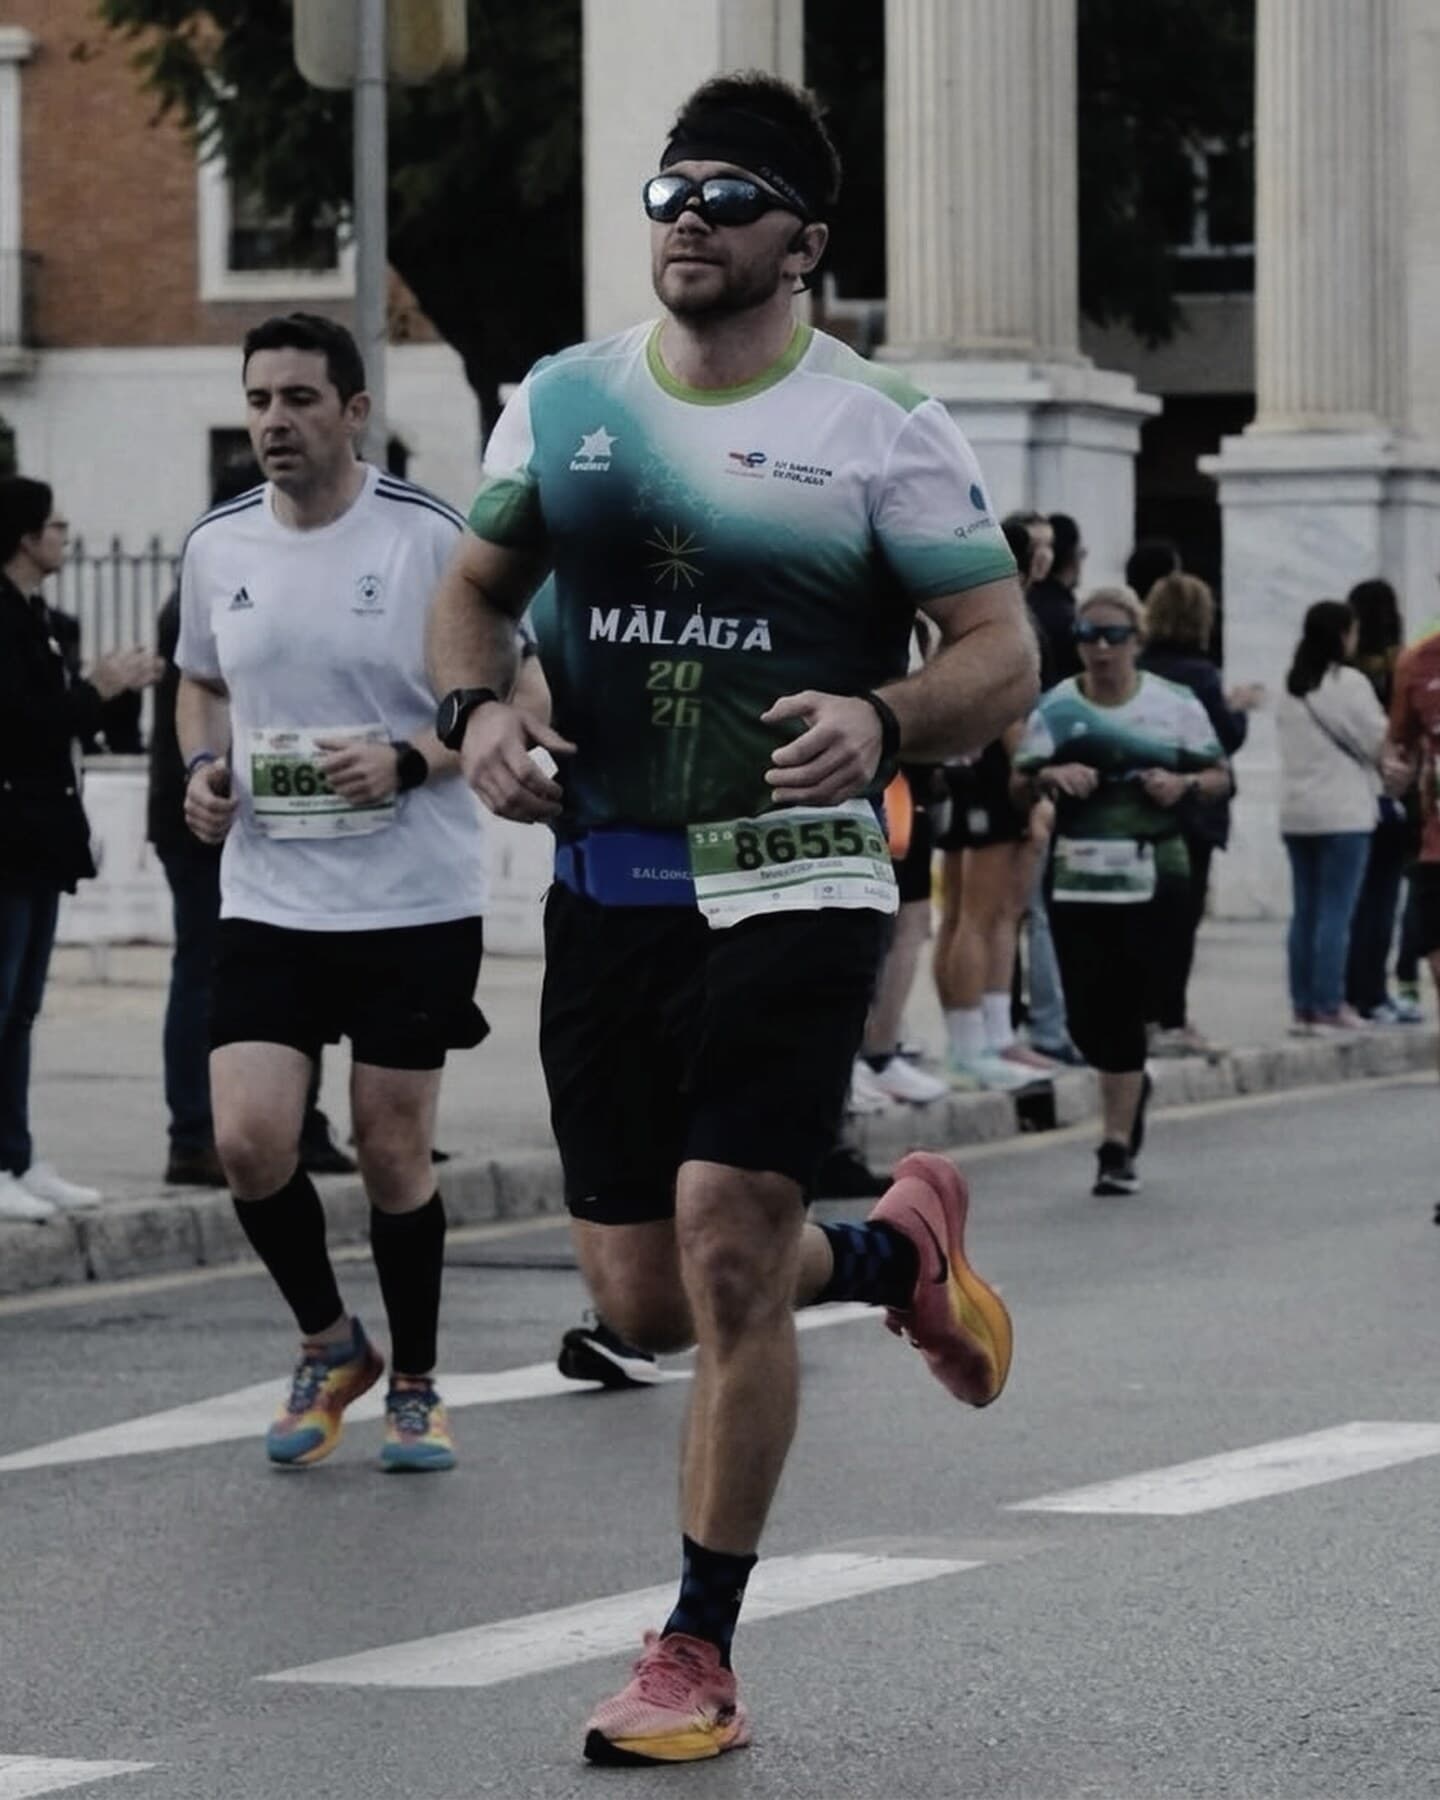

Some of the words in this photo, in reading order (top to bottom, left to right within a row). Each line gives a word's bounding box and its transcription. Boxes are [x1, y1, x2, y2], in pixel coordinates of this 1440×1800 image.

[646, 660, 703, 692] 20
[651, 696, 701, 728] 26
[734, 818, 865, 871] 8655
